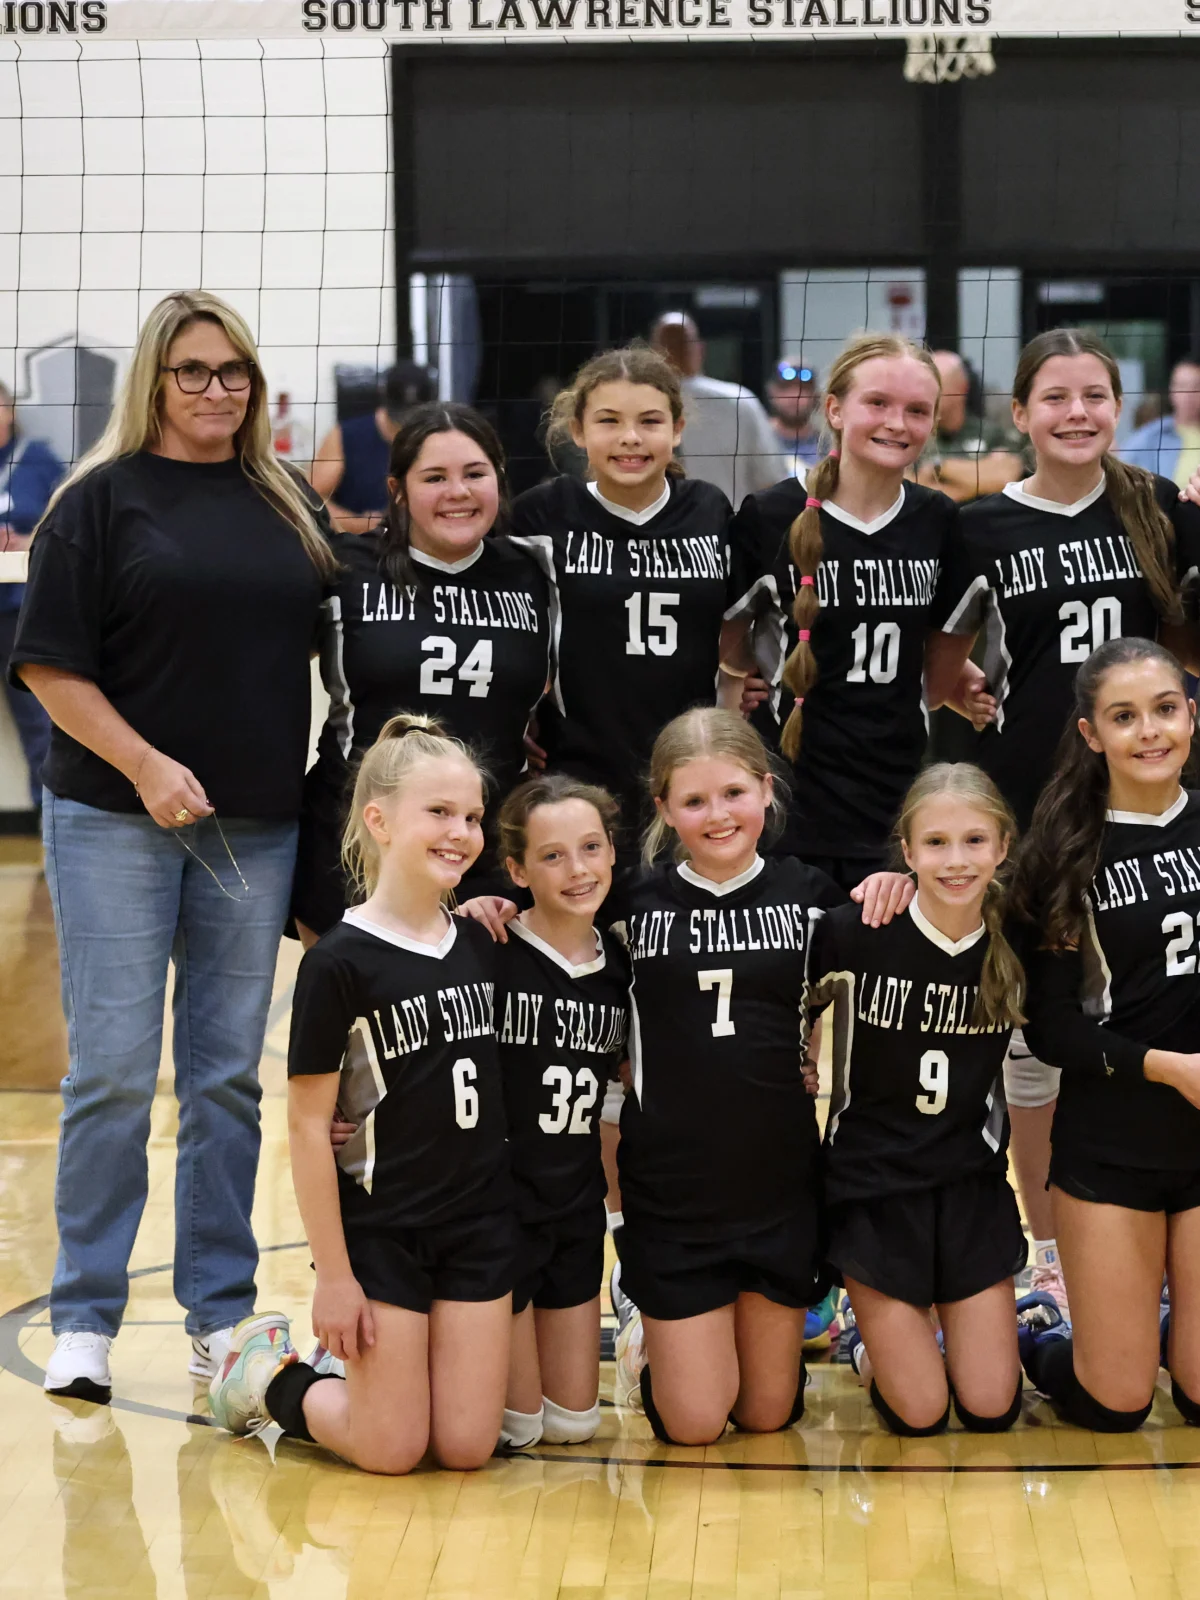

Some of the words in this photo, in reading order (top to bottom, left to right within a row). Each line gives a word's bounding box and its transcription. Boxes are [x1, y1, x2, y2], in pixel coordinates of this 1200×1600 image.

[0, 0, 107, 33] IONS
[302, 0, 453, 31] SOUTH
[468, 0, 732, 30] LAWRENCE
[747, 0, 991, 28] STALLIONS
[564, 530, 614, 575] LADY
[628, 534, 724, 580] STALLIONS
[788, 560, 840, 608] LDY
[995, 547, 1048, 599] LADY
[1058, 535, 1143, 586] STALLIO
[362, 582, 417, 622] LADY
[432, 585, 539, 633] STALLIONS
[624, 591, 681, 656] 15
[1058, 596, 1122, 664] 20
[419, 635, 494, 698] 24
[846, 621, 901, 684] 10
[1092, 858, 1149, 912] LADY
[630, 910, 676, 961] LADY
[689, 903, 804, 955] STALLIONS
[374, 994, 429, 1060] LADY
[495, 991, 543, 1046] ADY
[697, 968, 736, 1038] 7
[858, 971, 913, 1031] LADY
[452, 1057, 479, 1130] 6
[538, 1065, 599, 1135] 32
[915, 1049, 950, 1116] 9
